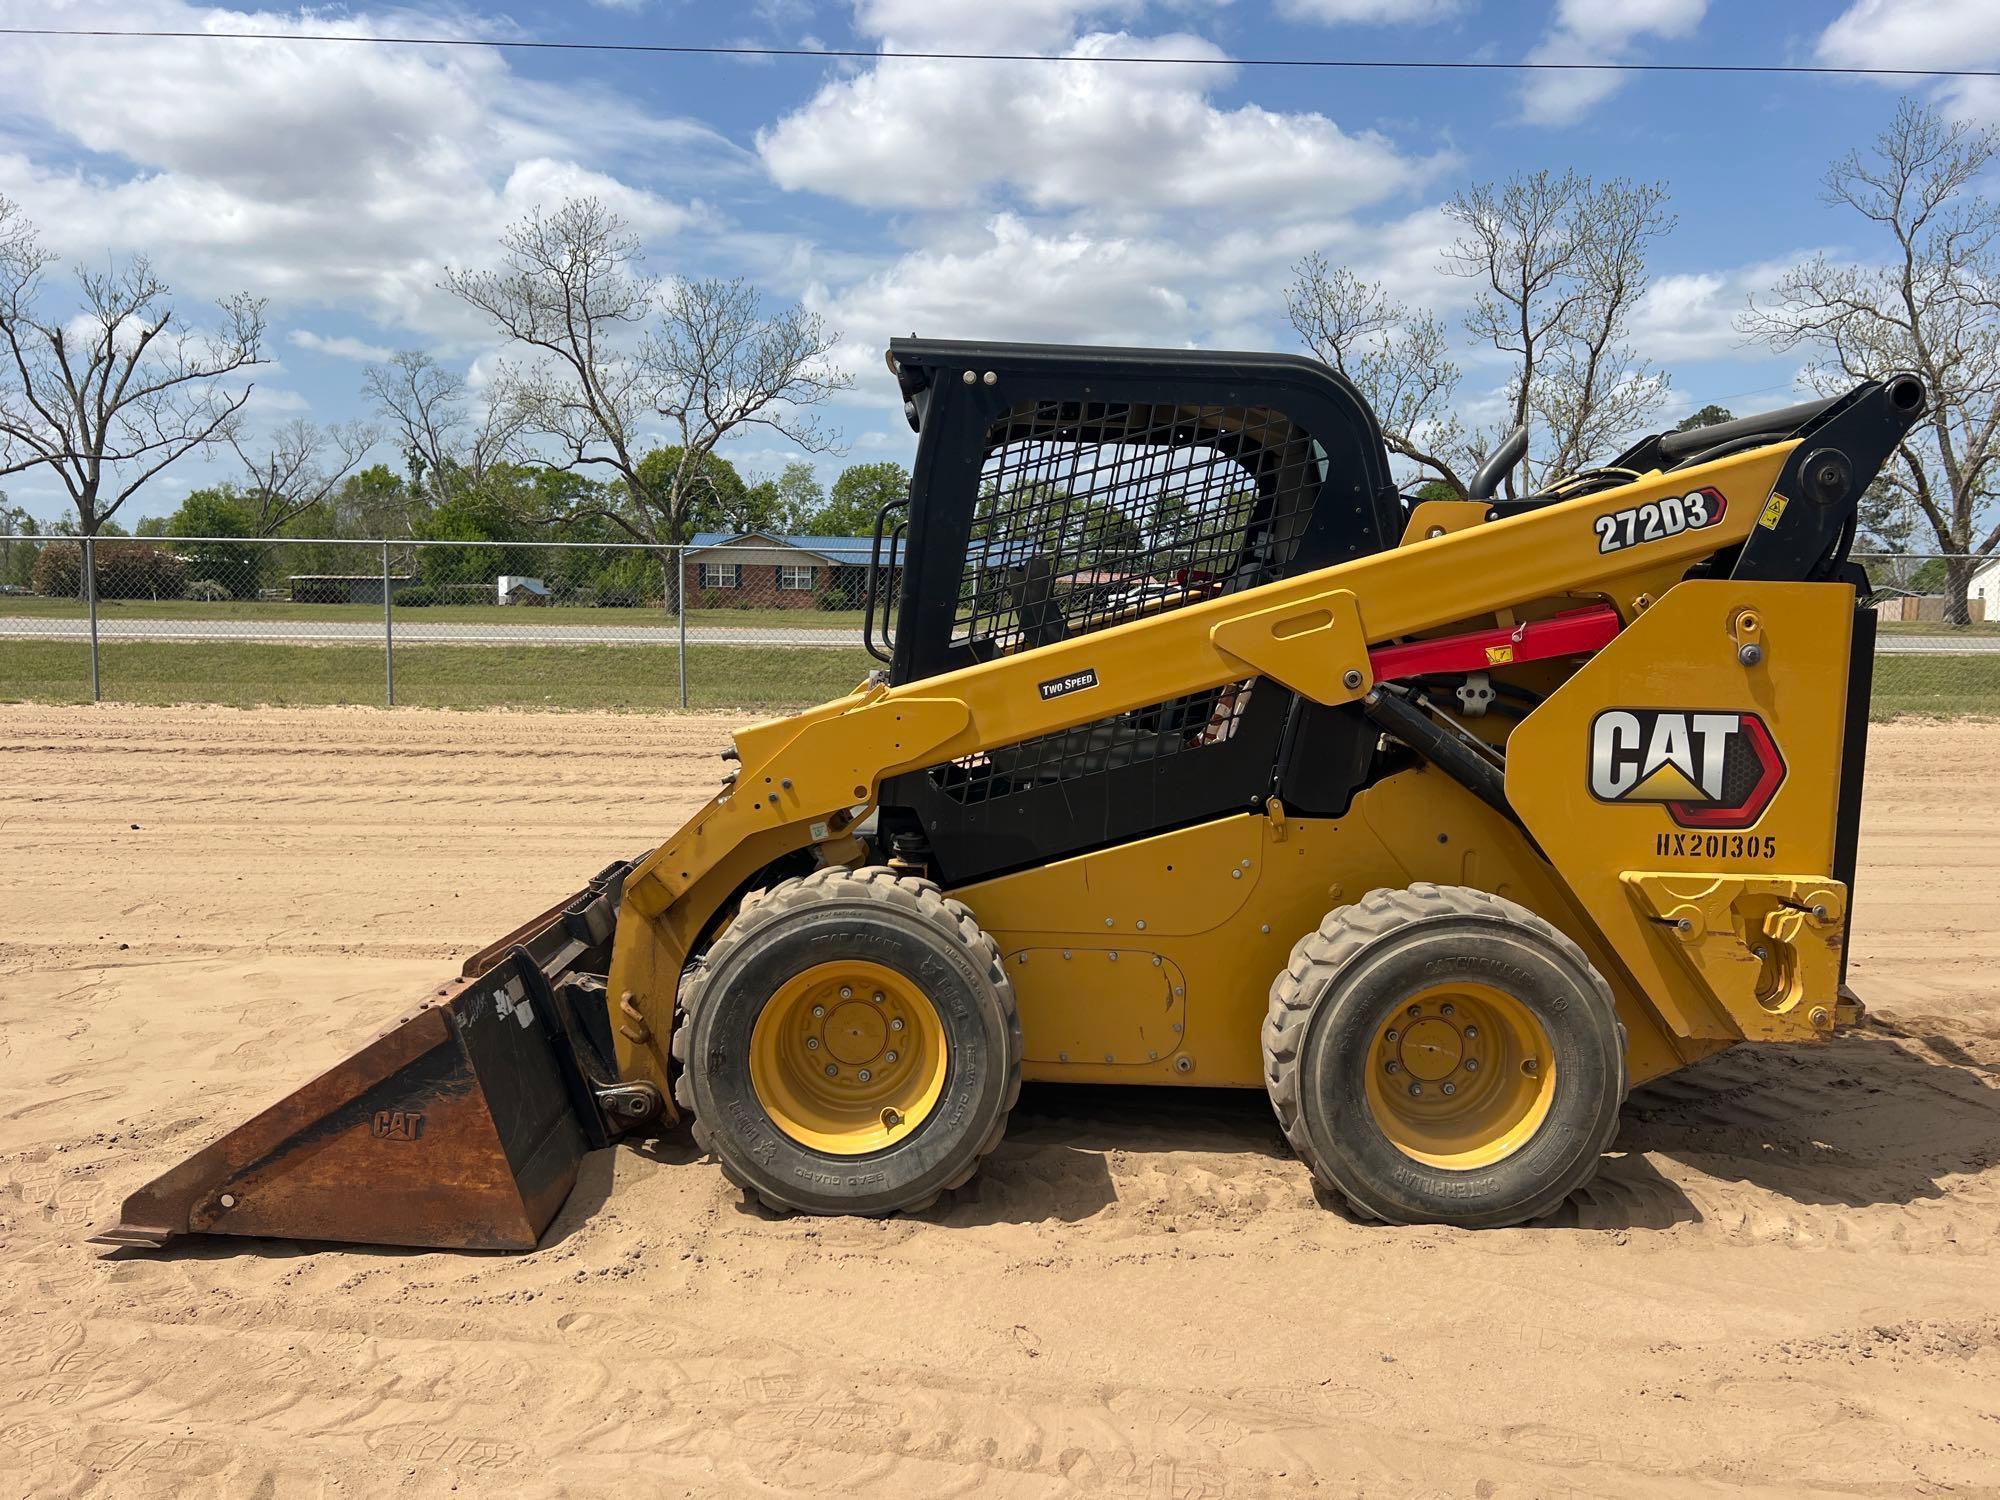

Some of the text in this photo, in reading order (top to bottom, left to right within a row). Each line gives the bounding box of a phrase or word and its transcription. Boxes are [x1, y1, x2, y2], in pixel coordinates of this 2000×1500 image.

[1595, 491, 1709, 553] 272D3
[1042, 674, 1093, 696] TWO SPEED
[1592, 710, 1740, 801] CAT
[1656, 833, 1776, 859] HX201305
[373, 1110, 421, 1140] CAT
[793, 1166, 886, 1187] BEAD GUARD
[1392, 1166, 1501, 1199] CATERPILLAR
